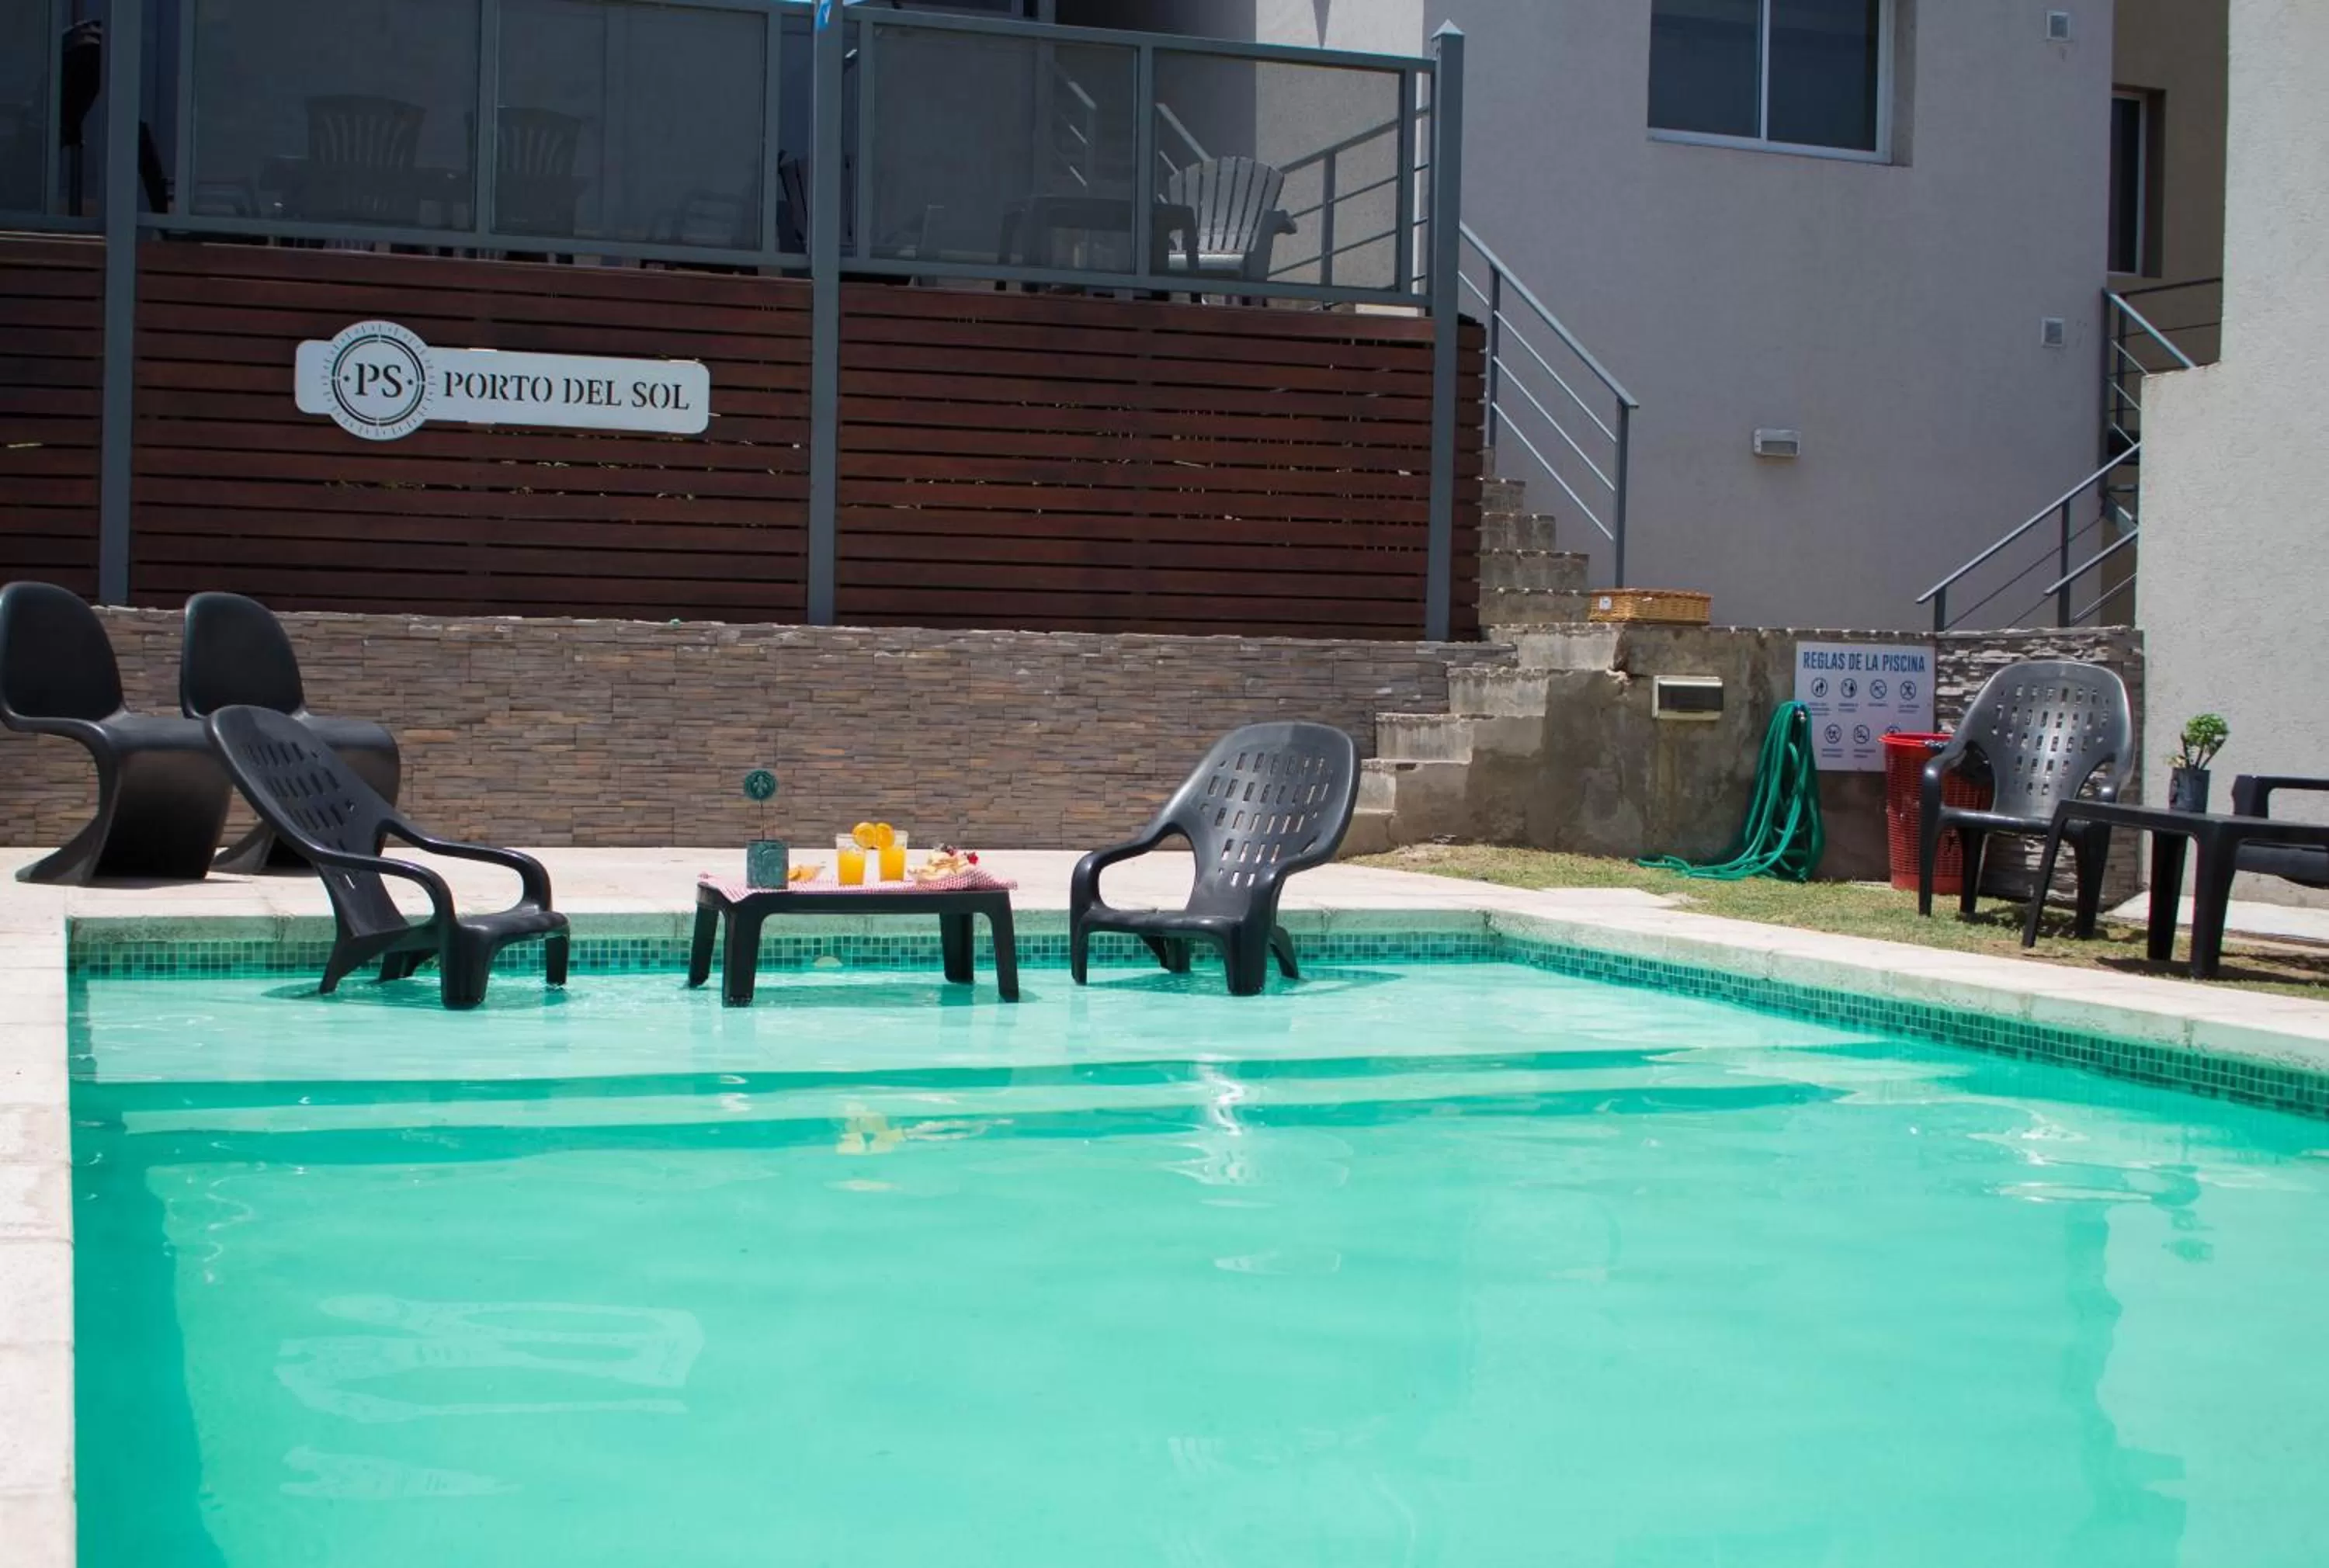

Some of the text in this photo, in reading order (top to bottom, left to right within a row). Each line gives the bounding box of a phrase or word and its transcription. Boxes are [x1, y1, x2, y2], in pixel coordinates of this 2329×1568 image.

[355, 363, 403, 398] PS
[443, 371, 690, 411] PORTO DEL SOL
[1803, 651, 1925, 673] REGLAS DE LA PISCINA
